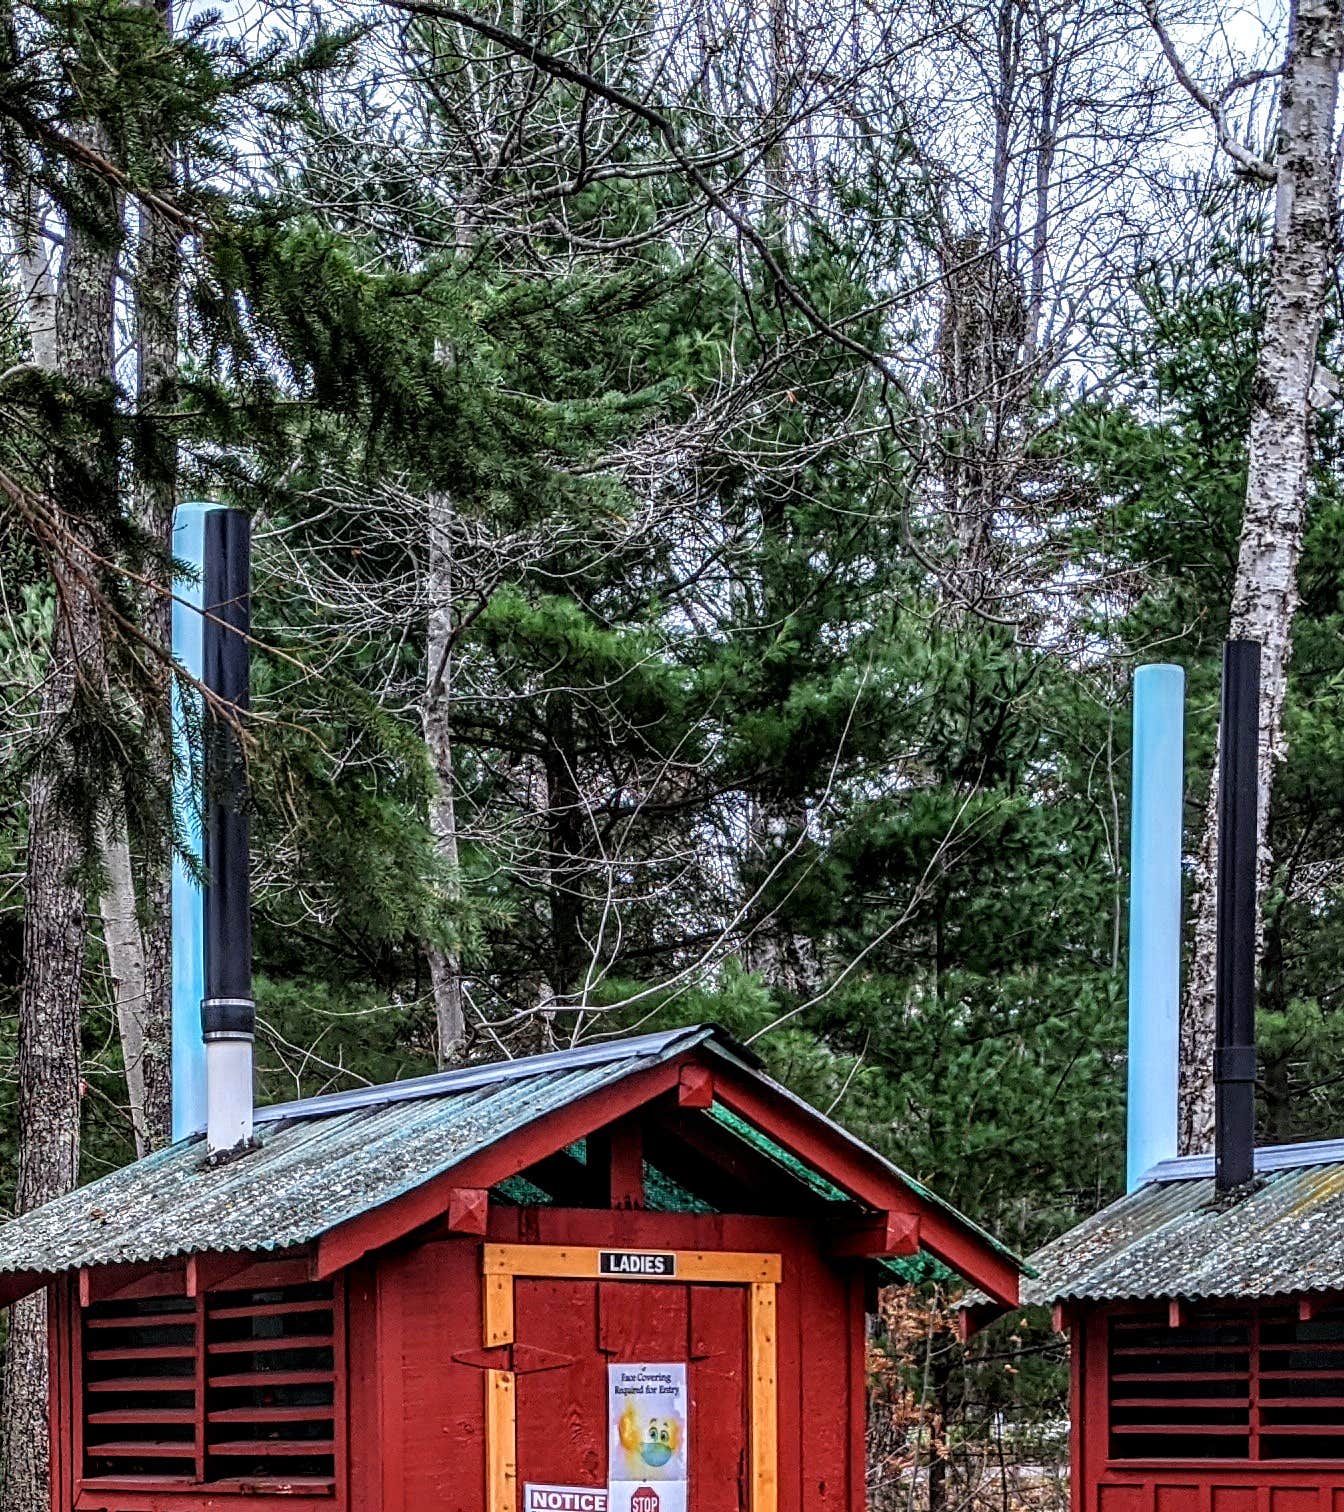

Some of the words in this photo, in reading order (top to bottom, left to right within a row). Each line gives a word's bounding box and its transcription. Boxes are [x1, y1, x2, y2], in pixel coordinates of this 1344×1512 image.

[610, 1254, 665, 1273] LADIES
[621, 1373, 636, 1382] Face
[637, 1373, 672, 1384] Covering
[615, 1385, 644, 1396] Required
[645, 1385, 657, 1394] for
[659, 1385, 680, 1397] Entry
[532, 1491, 607, 1512] NOTICE
[632, 1496, 658, 1512] STOP
